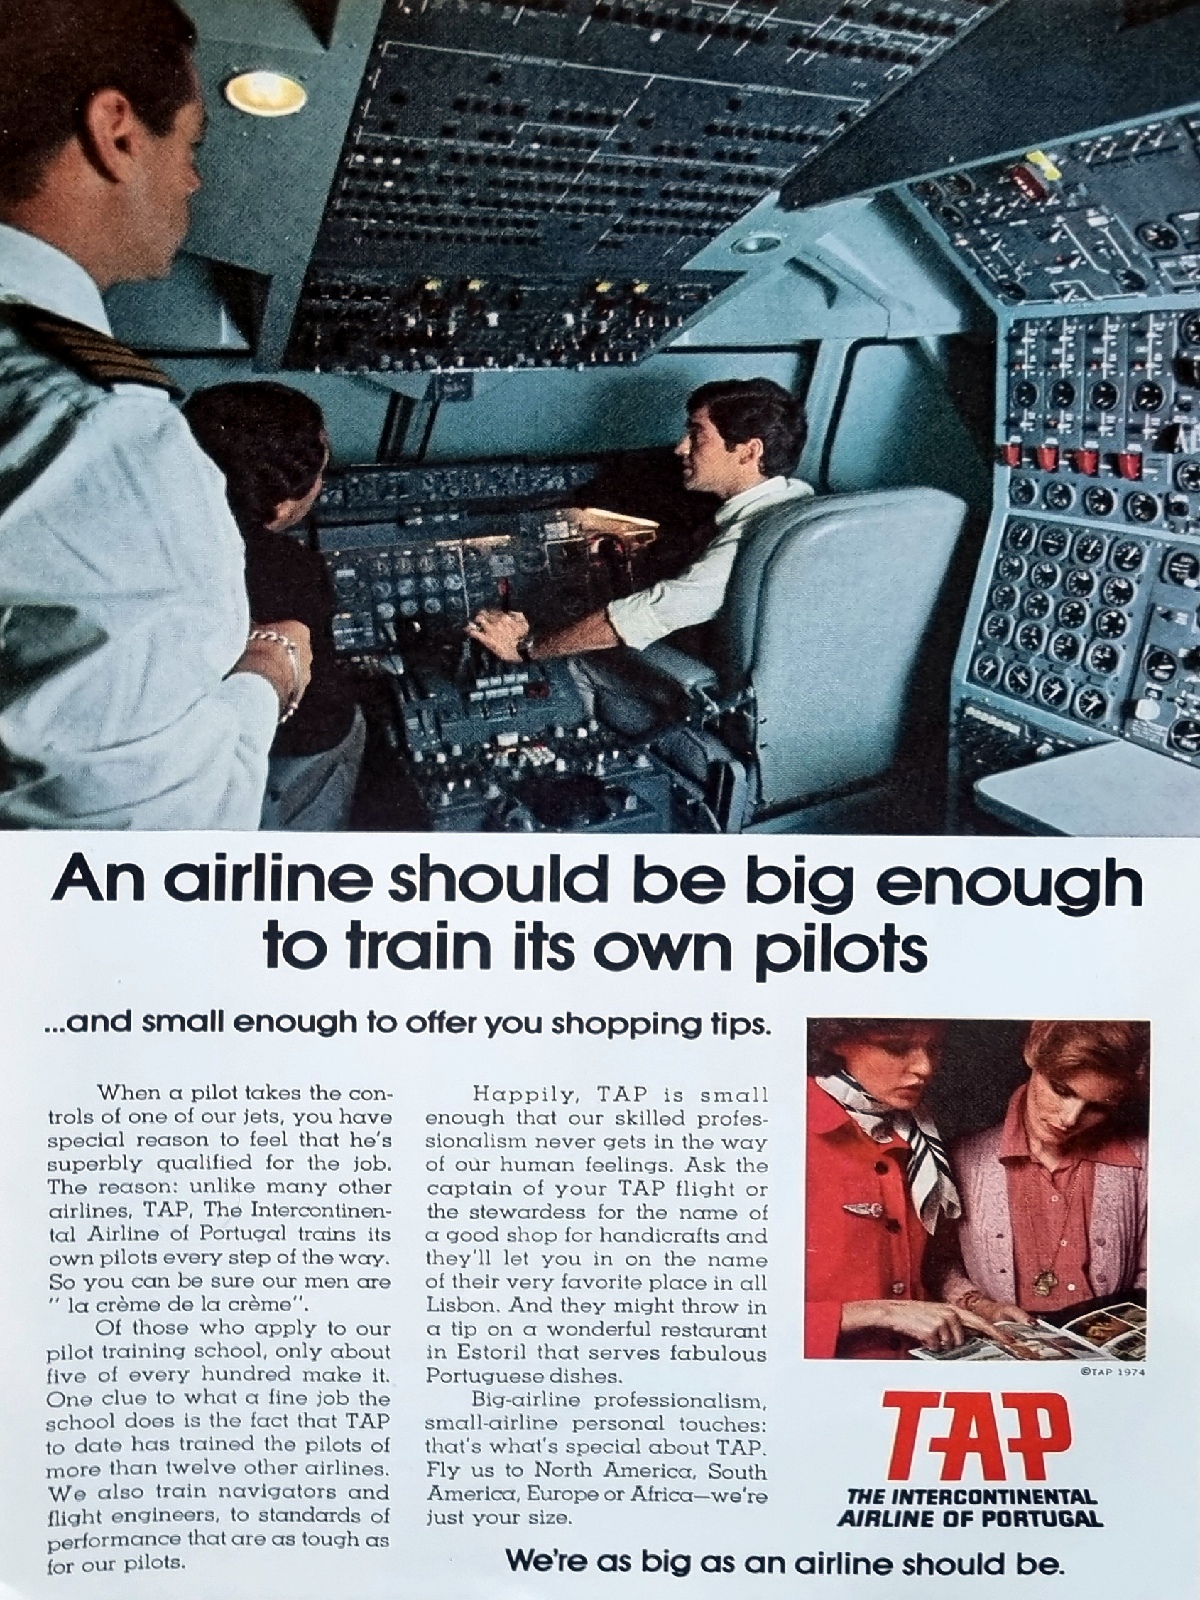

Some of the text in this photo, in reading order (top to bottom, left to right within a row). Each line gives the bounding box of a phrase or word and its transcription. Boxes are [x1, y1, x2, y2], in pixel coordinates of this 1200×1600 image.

[50, 851, 1143, 918] An airline should be big enough
[262, 919, 928, 984] to train its own pilots
[44, 1008, 772, 1041] ...and small enough to offer you shopping tips.
[96, 1083, 394, 1103] When a pilot takes the con-
[473, 1084, 768, 1105] Happily, TAP is small
[47, 1130, 392, 1152] special reason to feel that he's
[425, 1155, 769, 1175] of our human feelings. Ask the
[47, 1176, 393, 1197] The reason: unlike many other
[426, 1178, 769, 1199] captain of your TAP flight or
[48, 1200, 392, 1220] airlines, TAP, The Intercontinen-
[49, 1223, 392, 1243] tal Airline of Portugal trains its
[425, 1225, 768, 1246] a good shop for handicrafts and
[49, 1271, 392, 1292] So you can be sure our men are
[425, 1272, 767, 1293] of their very favorite place in all
[426, 1320, 767, 1339] a tip on a wonderful restaurant
[46, 1340, 391, 1364] pilot training school, only about
[426, 1342, 767, 1363] in Estoril that serves fabulous
[426, 1366, 623, 1386] Portuguese dishes.
[1118, 1368, 1146, 1376] 1974
[472, 1389, 767, 1412] Big-airline professionalism,
[424, 1413, 766, 1434] small-airline personal touches:
[425, 1436, 767, 1457] that's what's special about TAP.
[881, 1390, 1073, 1482] TAP
[45, 1458, 389, 1480] more than twelve other airlines.
[47, 1482, 390, 1503] We also train navigators and
[426, 1484, 521, 1503] America,
[527, 1484, 600, 1505] Europe
[603, 1489, 626, 1502] or
[847, 1488, 1099, 1506] THE INTERCONTINENTAL
[836, 1509, 1105, 1528] AIRLINE OF PORTUGAL
[47, 1528, 390, 1555] performance that are as tough as
[47, 1553, 186, 1576] for our pilots.
[505, 1548, 1065, 1578] We're as big as an airline should be.
